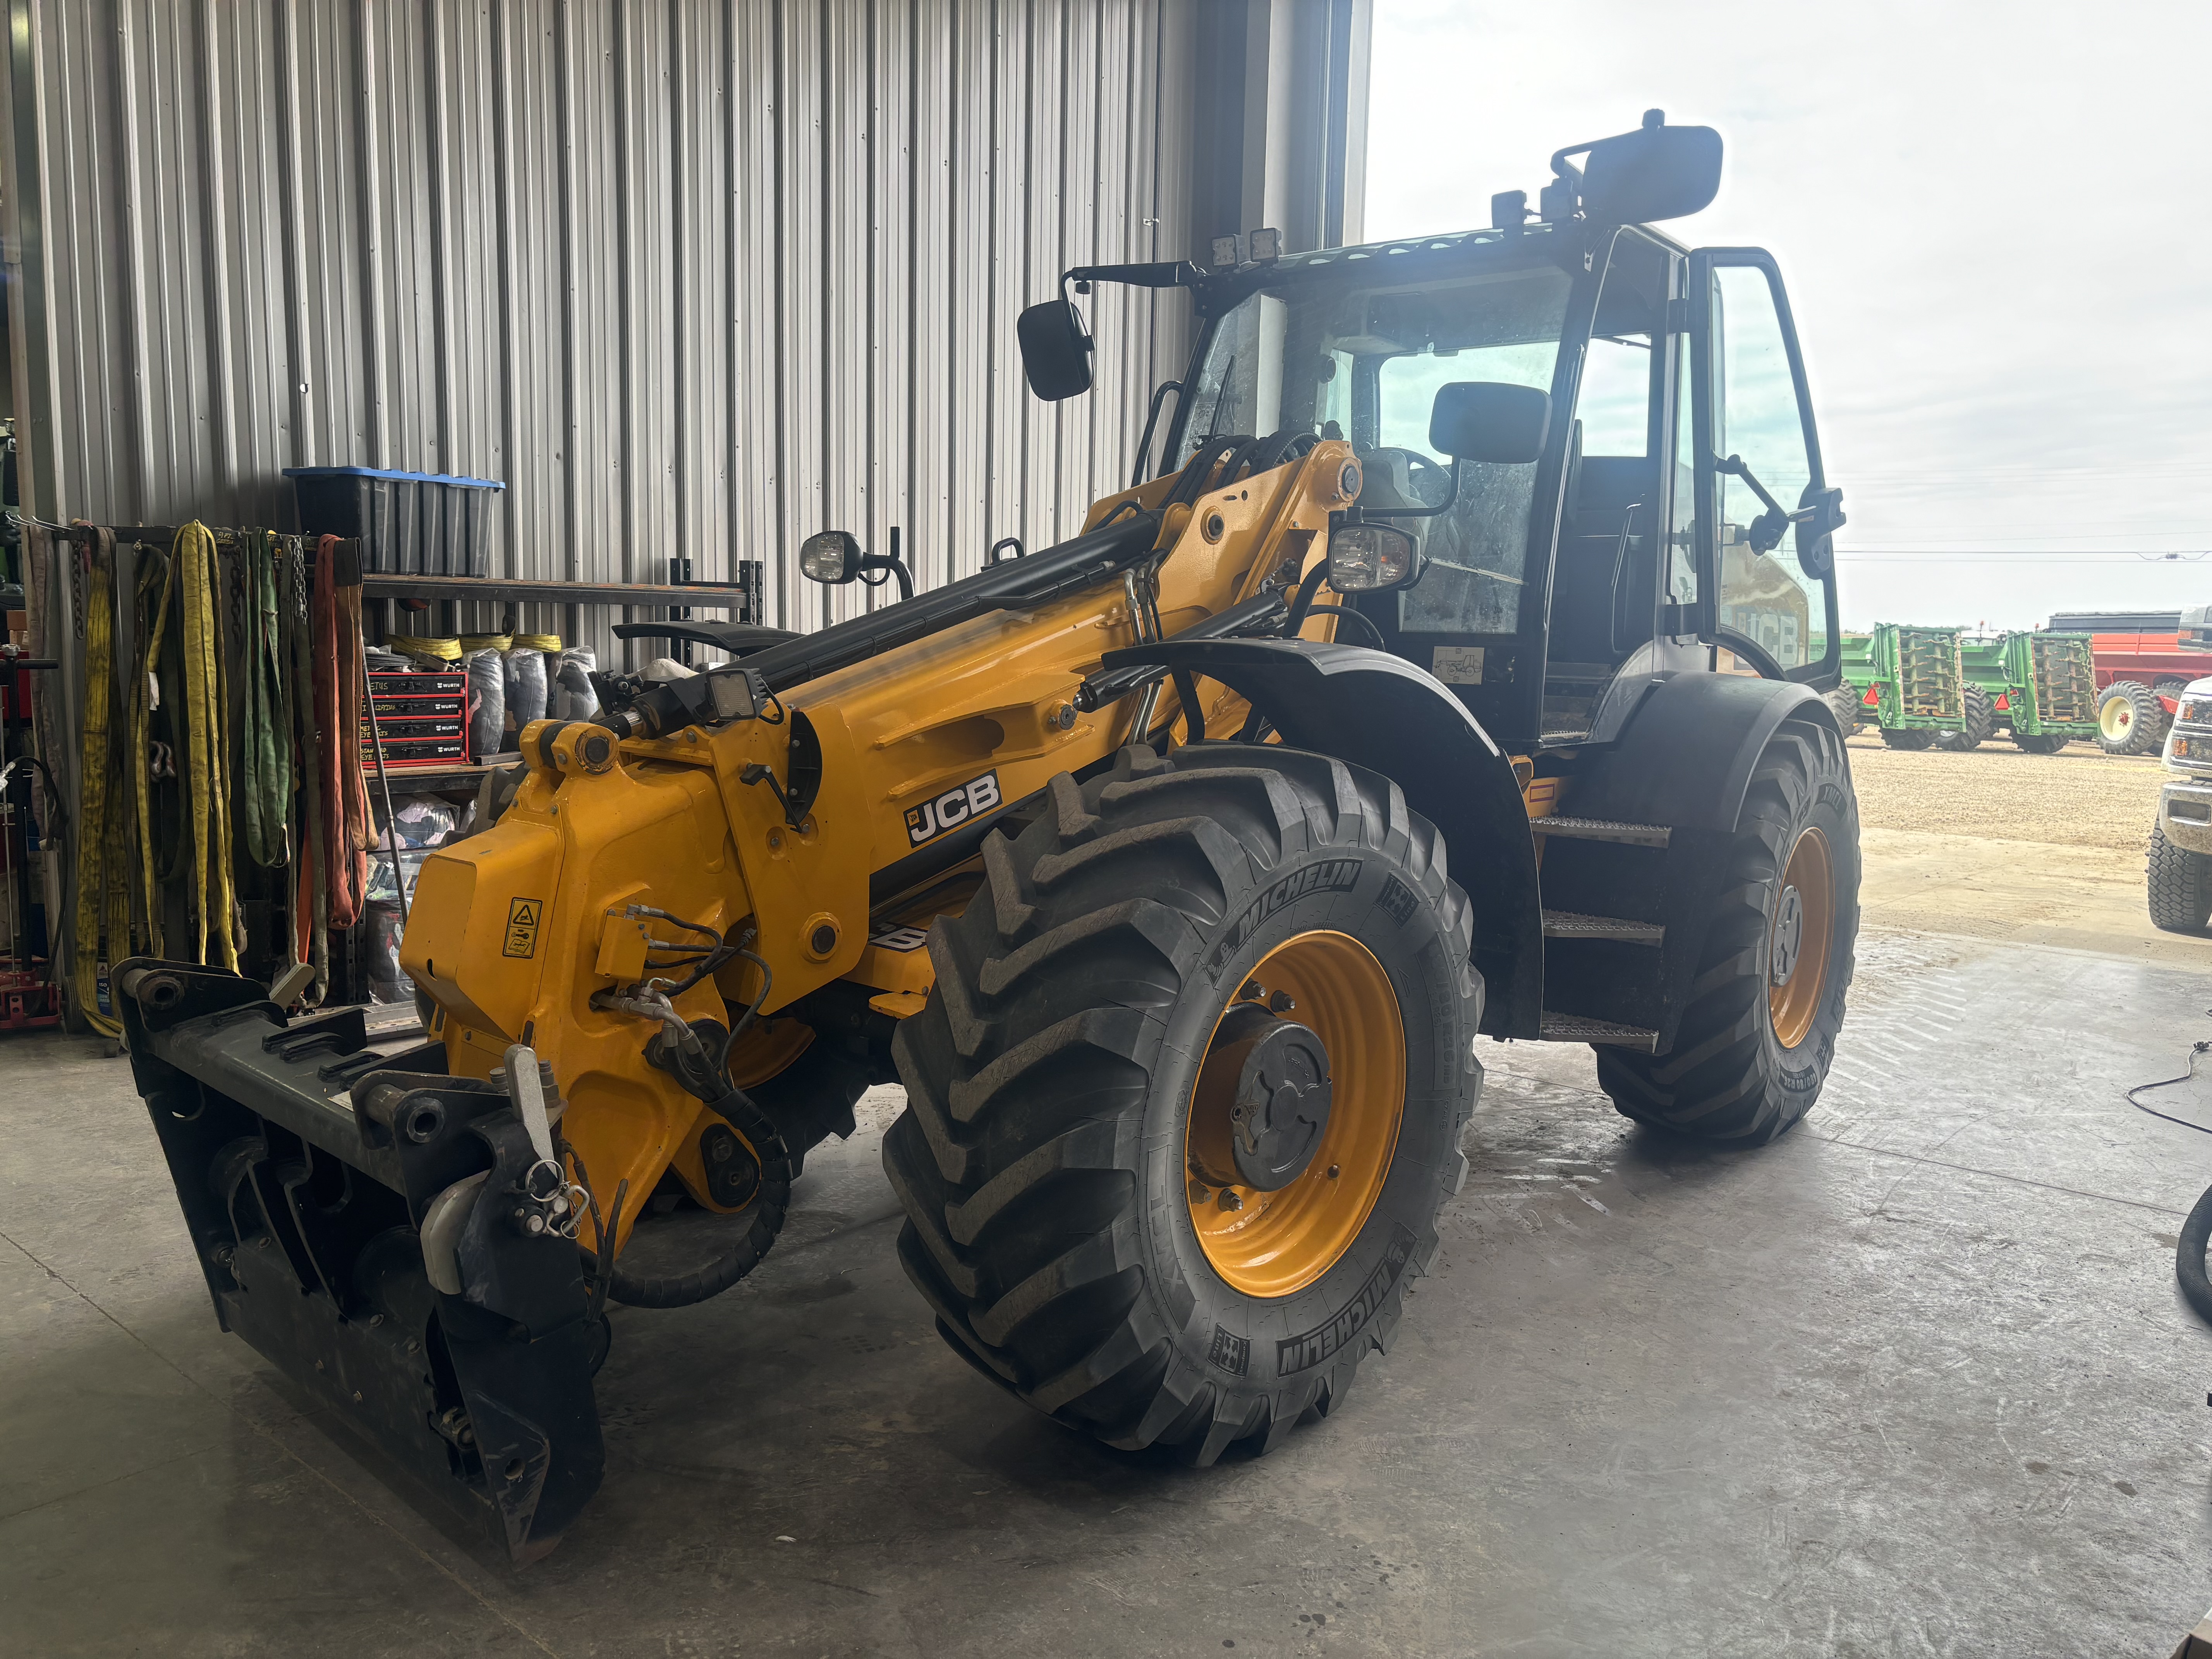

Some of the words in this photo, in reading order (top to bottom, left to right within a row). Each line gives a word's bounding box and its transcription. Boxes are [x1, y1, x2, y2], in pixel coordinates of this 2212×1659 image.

[1736, 609, 1798, 665] JCB
[370, 682, 388, 690] ETUS
[911, 775, 999, 842] JCB
[1821, 786, 1842, 810] XMCL
[1239, 862, 1361, 942] MICHELIN
[1151, 1185, 1184, 1300] XMCL
[1279, 1264, 1393, 1374] MICHELIN
